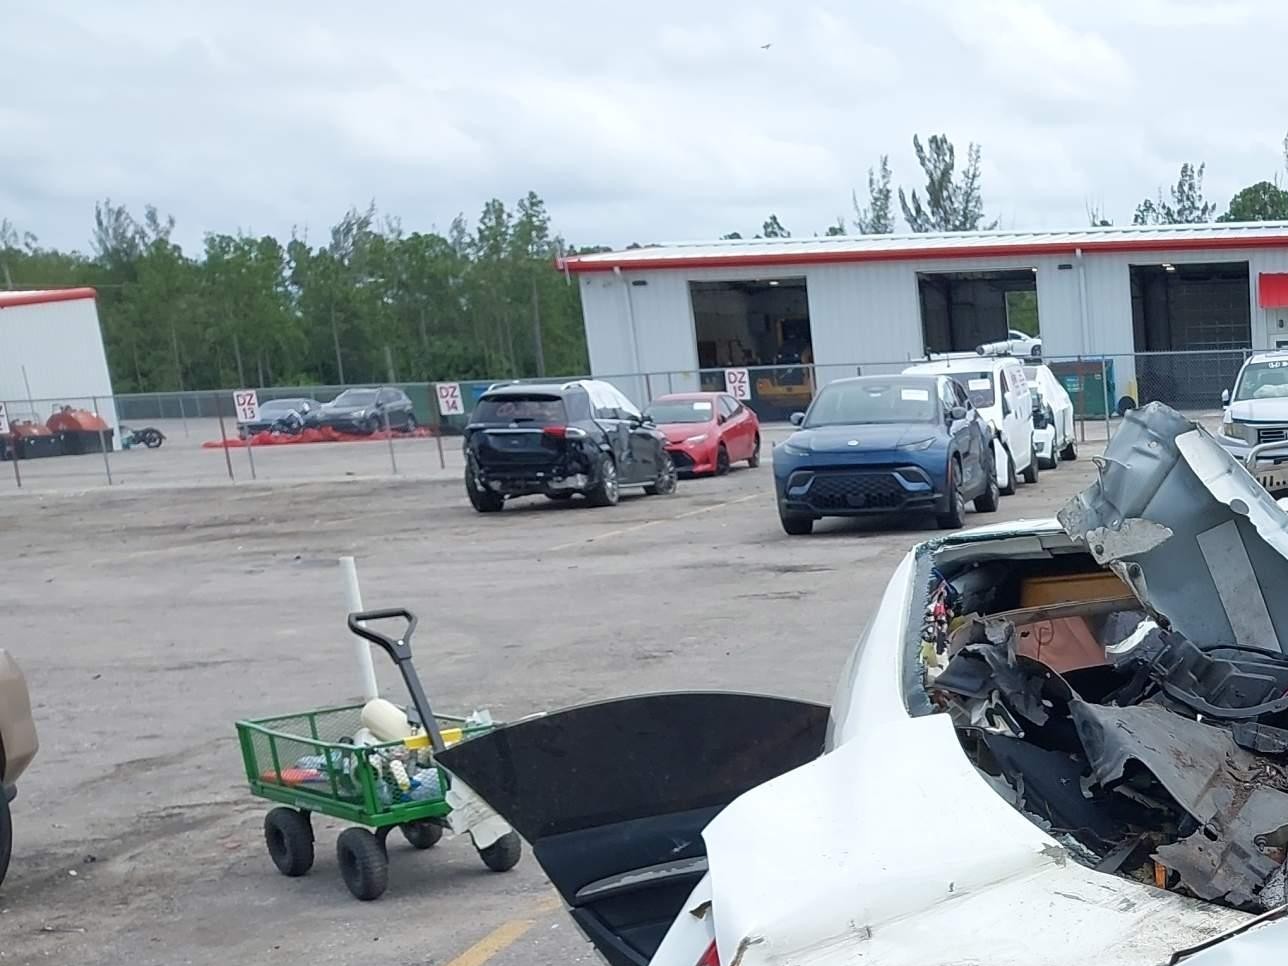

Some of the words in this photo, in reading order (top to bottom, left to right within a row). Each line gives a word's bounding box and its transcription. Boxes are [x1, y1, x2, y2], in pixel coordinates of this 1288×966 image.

[728, 371, 746, 384] DZ
[440, 386, 458, 399] DZ
[733, 385, 746, 397] 15
[236, 393, 255, 406] DZ
[446, 399, 458, 411] 14
[242, 407, 255, 419] 13
